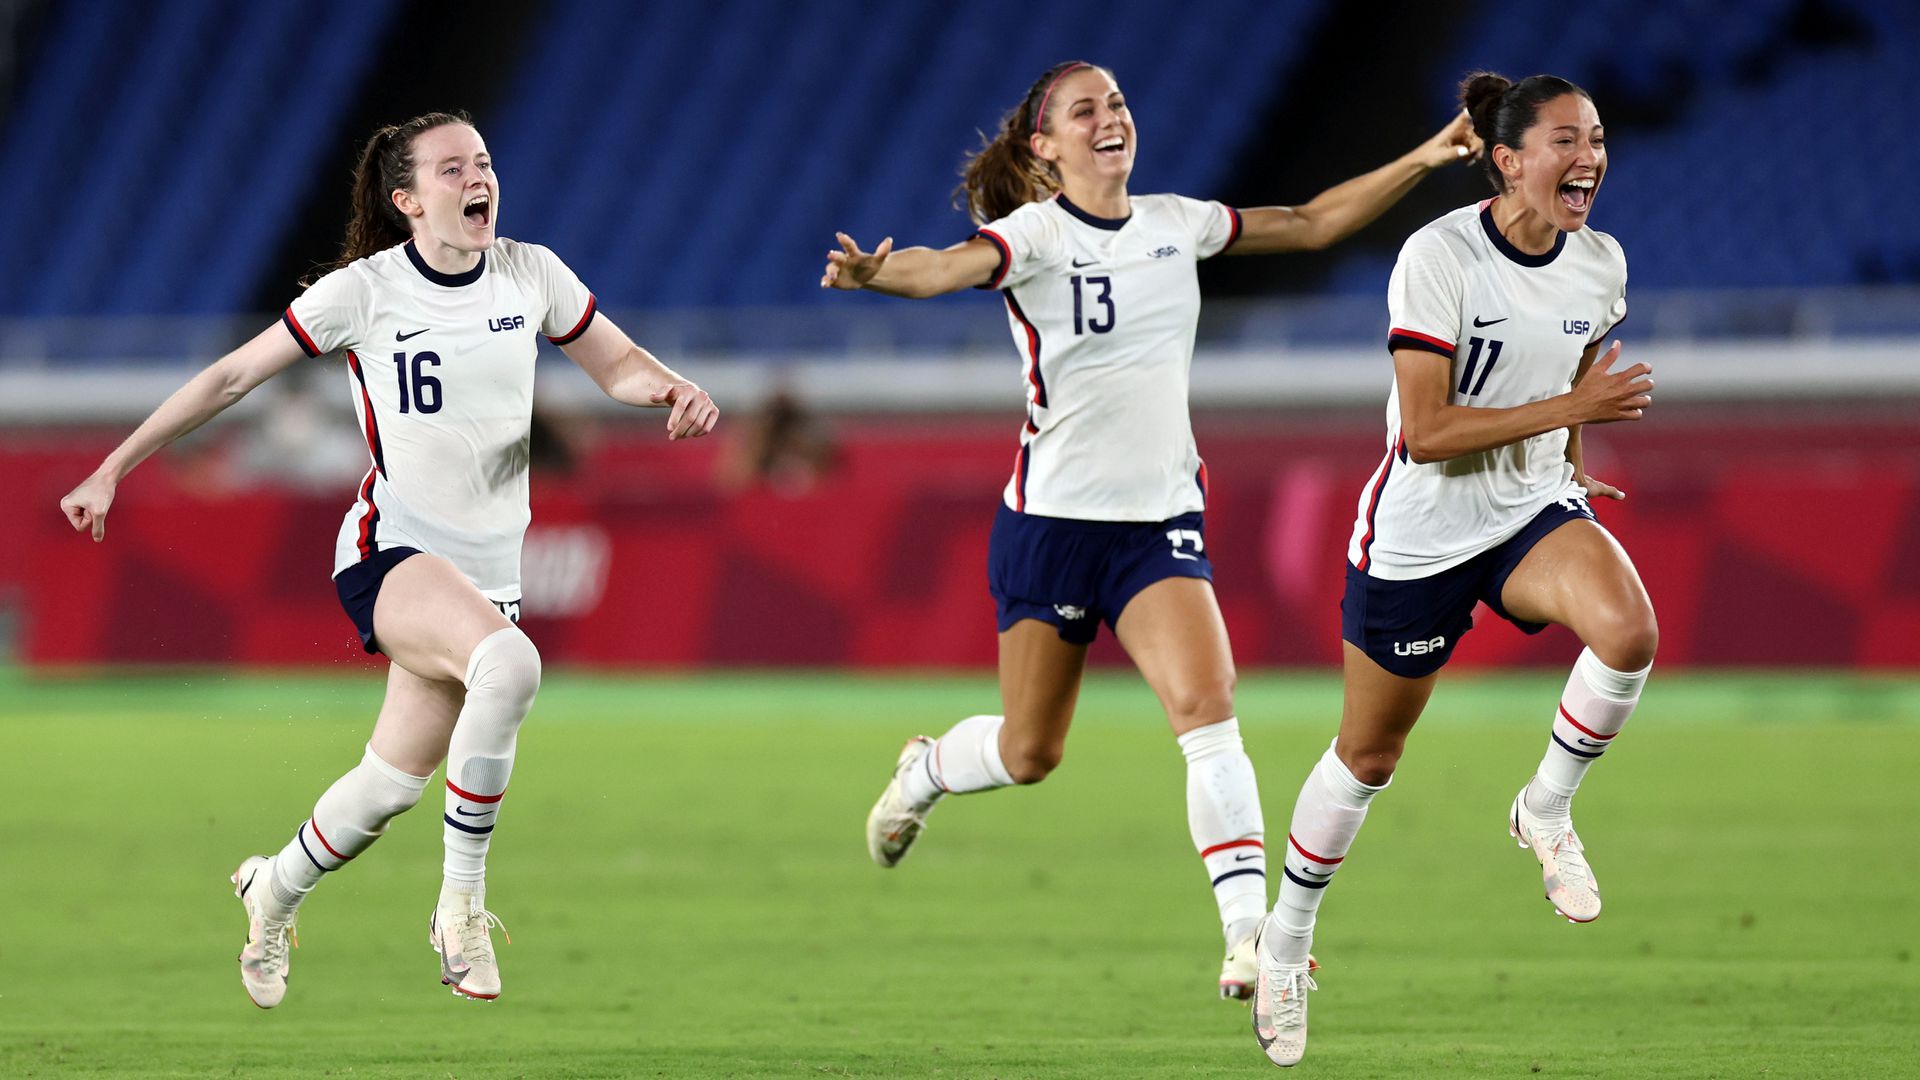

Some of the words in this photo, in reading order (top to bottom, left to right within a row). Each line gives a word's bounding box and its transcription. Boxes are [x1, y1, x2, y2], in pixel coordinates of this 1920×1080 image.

[487, 315, 525, 332] USA
[1070, 274, 1115, 335] 13
[1563, 320, 1590, 335] USA
[393, 351, 443, 414] 16
[1457, 336, 1504, 396] 11
[1394, 635, 1445, 656] USA
